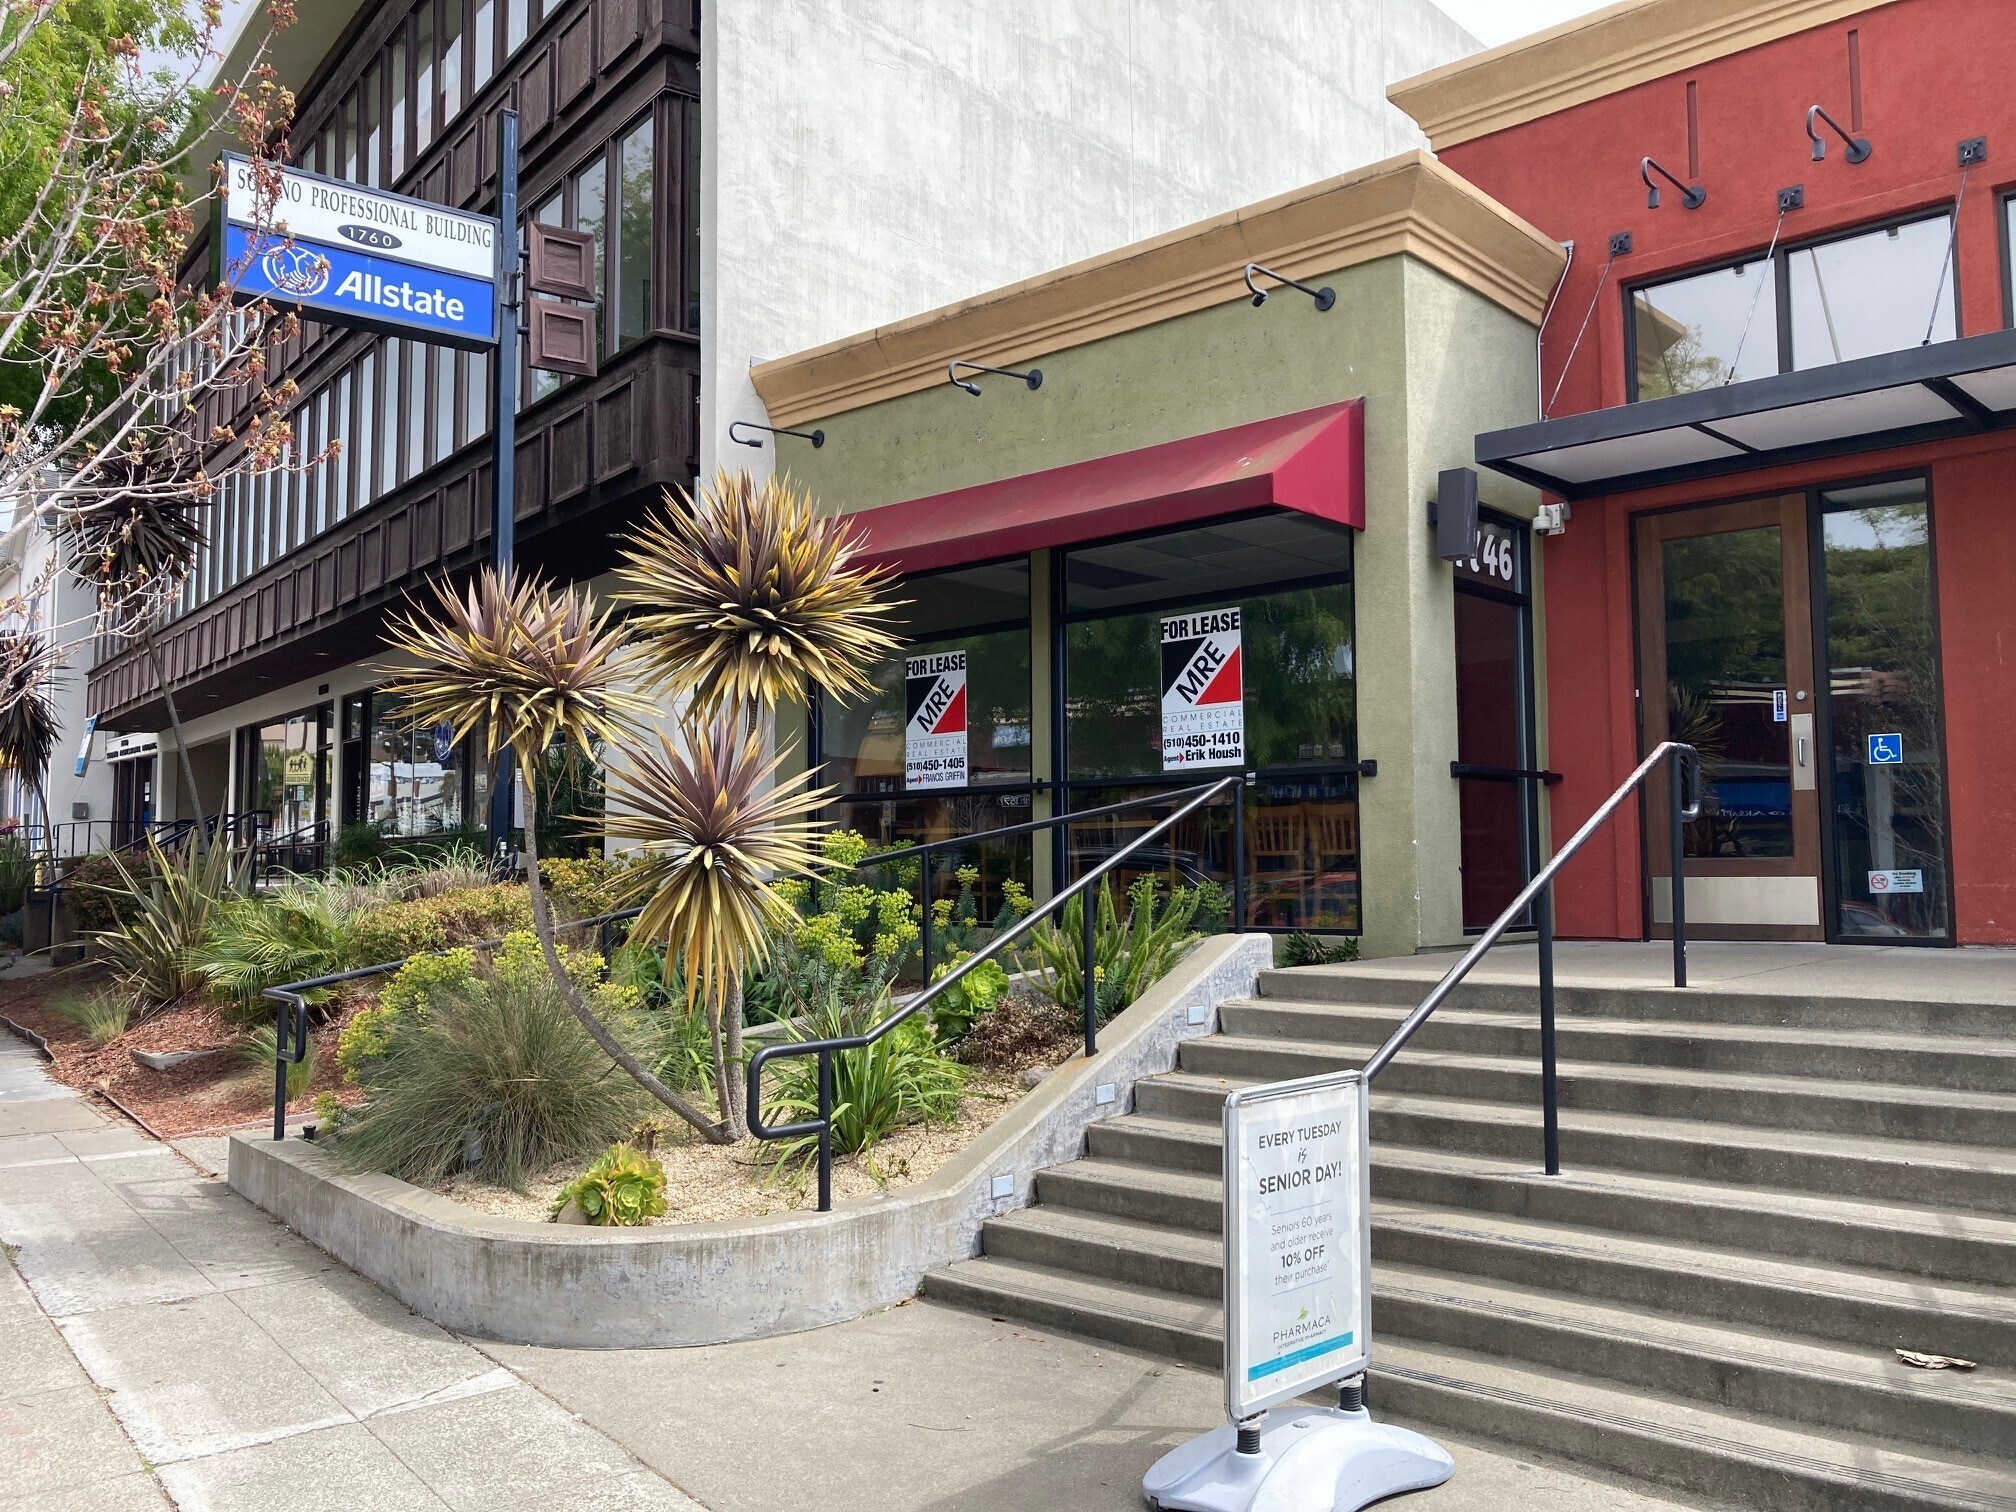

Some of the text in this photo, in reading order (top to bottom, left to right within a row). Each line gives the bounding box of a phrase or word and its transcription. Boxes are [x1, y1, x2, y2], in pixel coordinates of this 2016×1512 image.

[237, 168, 492, 248] SONO PROFESSIONAL BUILDING
[348, 226, 393, 247] 1760
[335, 270, 465, 321] Allstate
[1160, 611, 1240, 641] FOR LEASE
[906, 653, 966, 678] FOR LEASE
[1175, 640, 1226, 704] MRE
[917, 677, 955, 733] MRE
[1162, 708, 1242, 724] COMMERCIAL
[1162, 720, 1242, 733] REAL ESTATE
[906, 738, 967, 750] COMMERCIAL
[906, 746, 967, 758] REAL ESTATE
[1163, 746, 1242, 763] Agent Erik Housh
[922, 772, 944, 783] FRANCIS
[945, 770, 966, 781] GRIFFIN
[1258, 1120, 1342, 1149] EVERY TUESDAY
[1297, 1147, 1308, 1164] is
[1259, 1160, 1342, 1195] SENIOR DAY!
[1271, 1212, 1332, 1236] Seniors 60 years
[1270, 1227, 1334, 1252] and older receive
[1281, 1244, 1325, 1268] 10% OFF
[1275, 1273, 1293, 1286] their
[1272, 1314, 1332, 1344] PHARMACA
